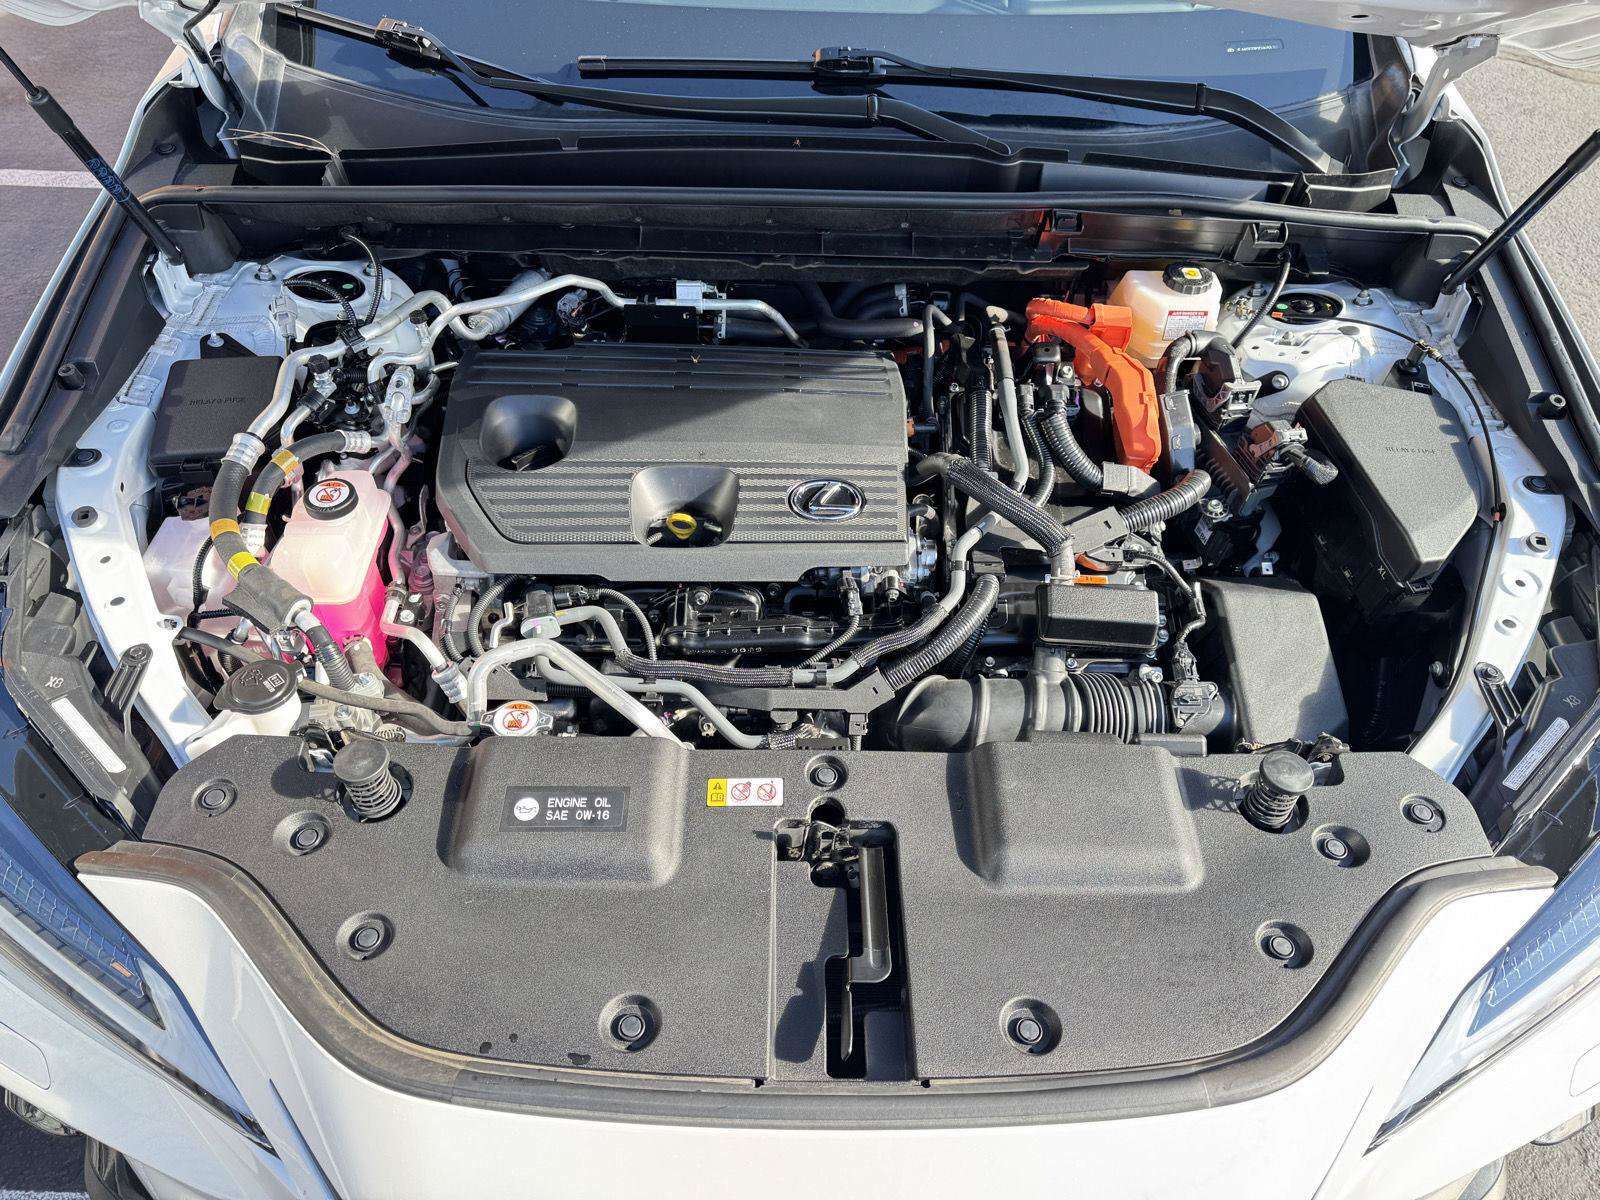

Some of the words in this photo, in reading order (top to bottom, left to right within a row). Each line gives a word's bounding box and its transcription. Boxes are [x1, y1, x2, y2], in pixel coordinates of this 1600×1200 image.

[44, 675, 65, 689] X8
[1562, 694, 1582, 709] X8
[547, 796, 588, 808] ENGINE
[594, 796, 612, 808] OIL
[545, 810, 569, 821] SAE
[575, 810, 611, 821] 0W-16
